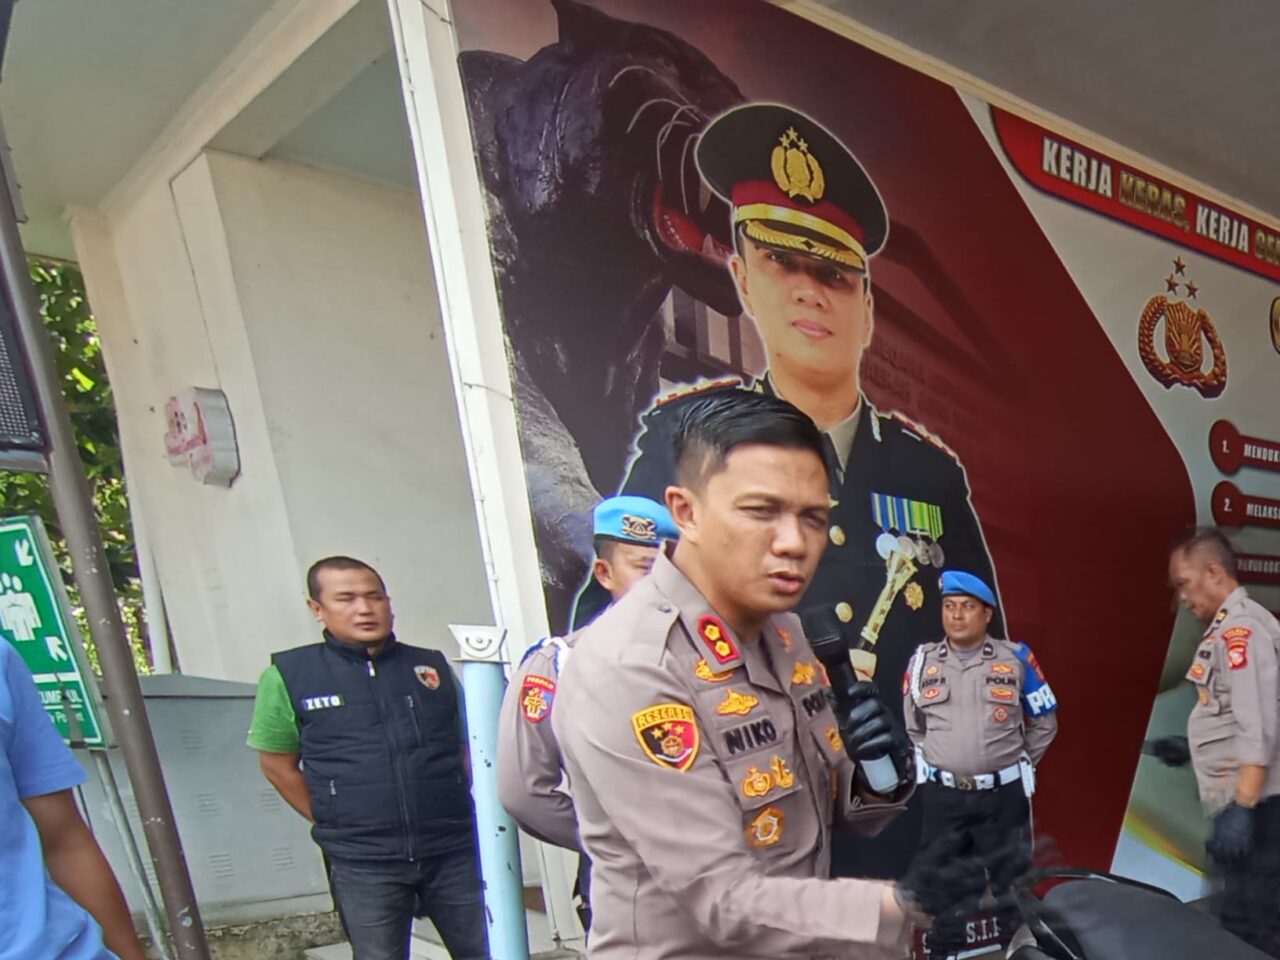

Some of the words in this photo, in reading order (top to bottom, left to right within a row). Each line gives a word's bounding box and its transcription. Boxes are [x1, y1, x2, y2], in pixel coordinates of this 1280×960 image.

[1043, 136, 1112, 198] KERJA
[1196, 204, 1249, 253] KERJA
[306, 695, 341, 710] ZETO
[637, 707, 693, 728] RESERSE
[724, 718, 777, 755] NIKO
